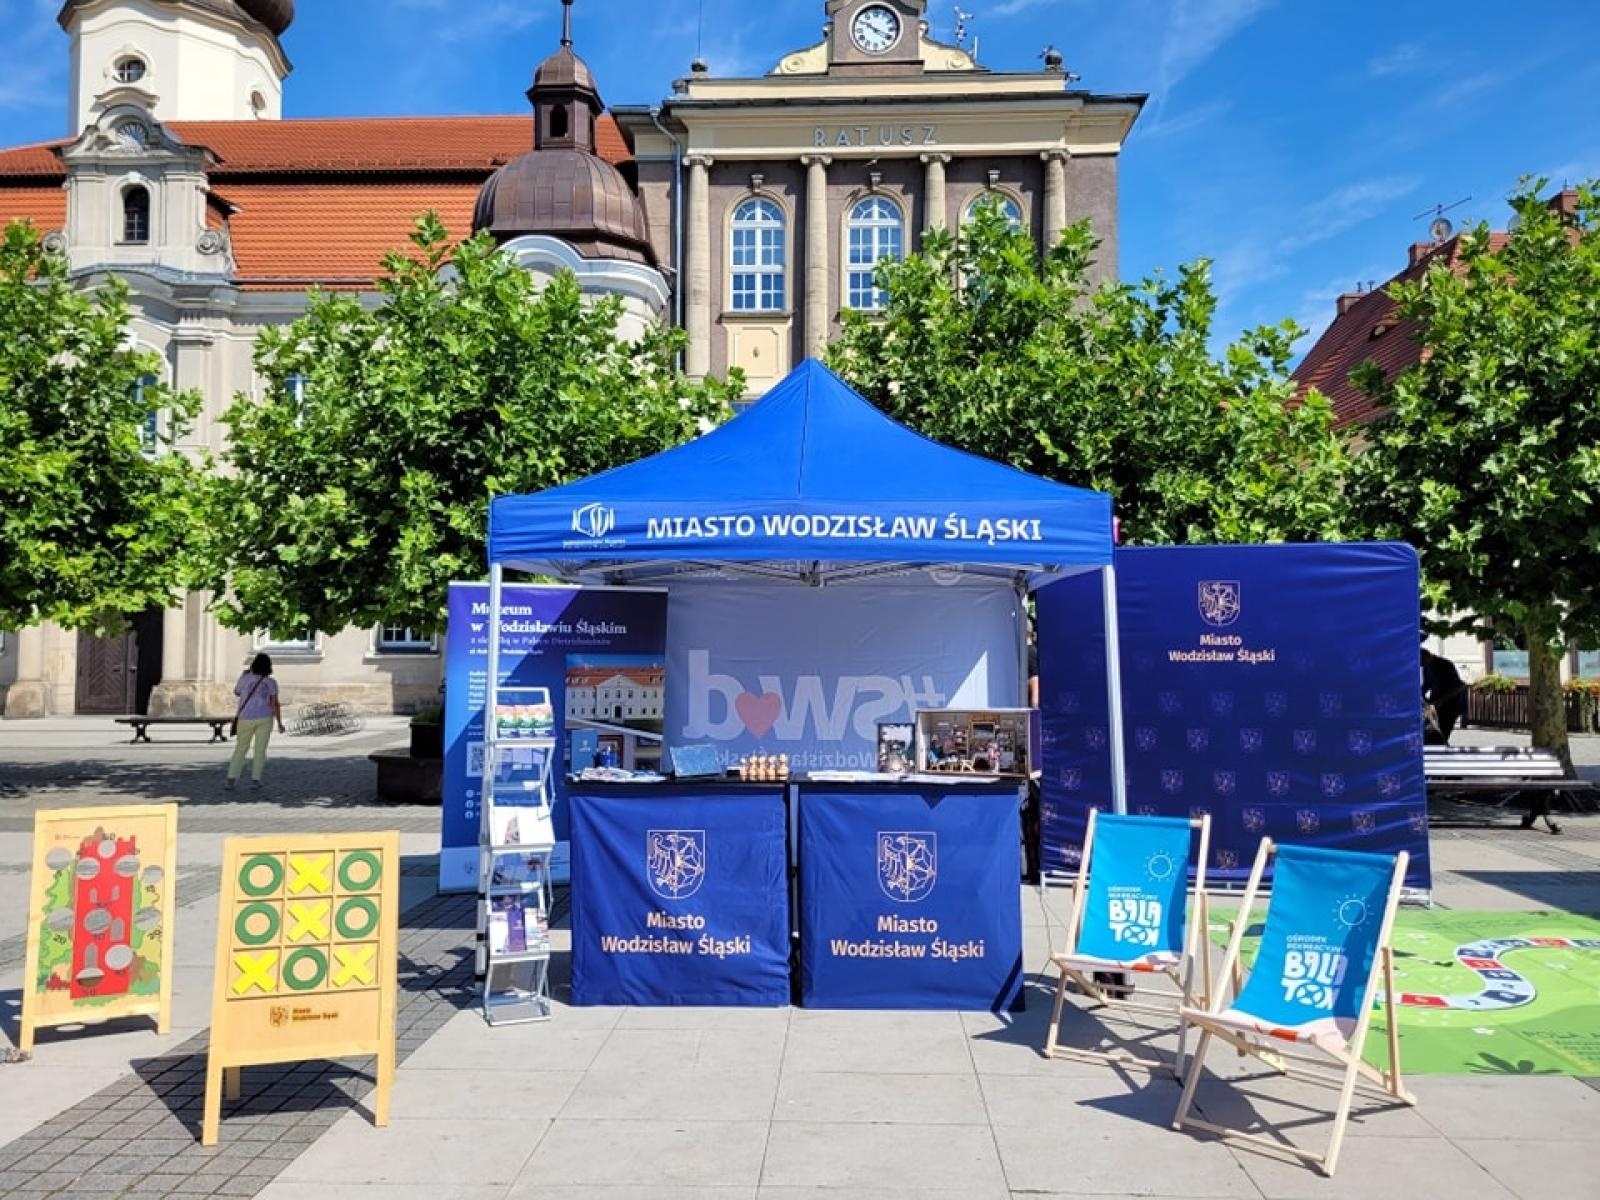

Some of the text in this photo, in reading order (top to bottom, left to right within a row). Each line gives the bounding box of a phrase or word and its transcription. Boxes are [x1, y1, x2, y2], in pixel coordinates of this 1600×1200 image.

[814, 126, 937, 147] RATUSZ
[647, 512, 1042, 545] MIASTO WODZISŁAW ŚLĄSKI
[576, 618, 628, 636] Śląskim
[1200, 633, 1242, 646] Miasto
[1168, 647, 1276, 664] Wodzisław Śląski
[646, 911, 706, 929] Miasto
[877, 914, 938, 933] Miasto
[601, 933, 751, 960] Wodzisław Śląski
[831, 936, 985, 963] Wodzisław Śląski
